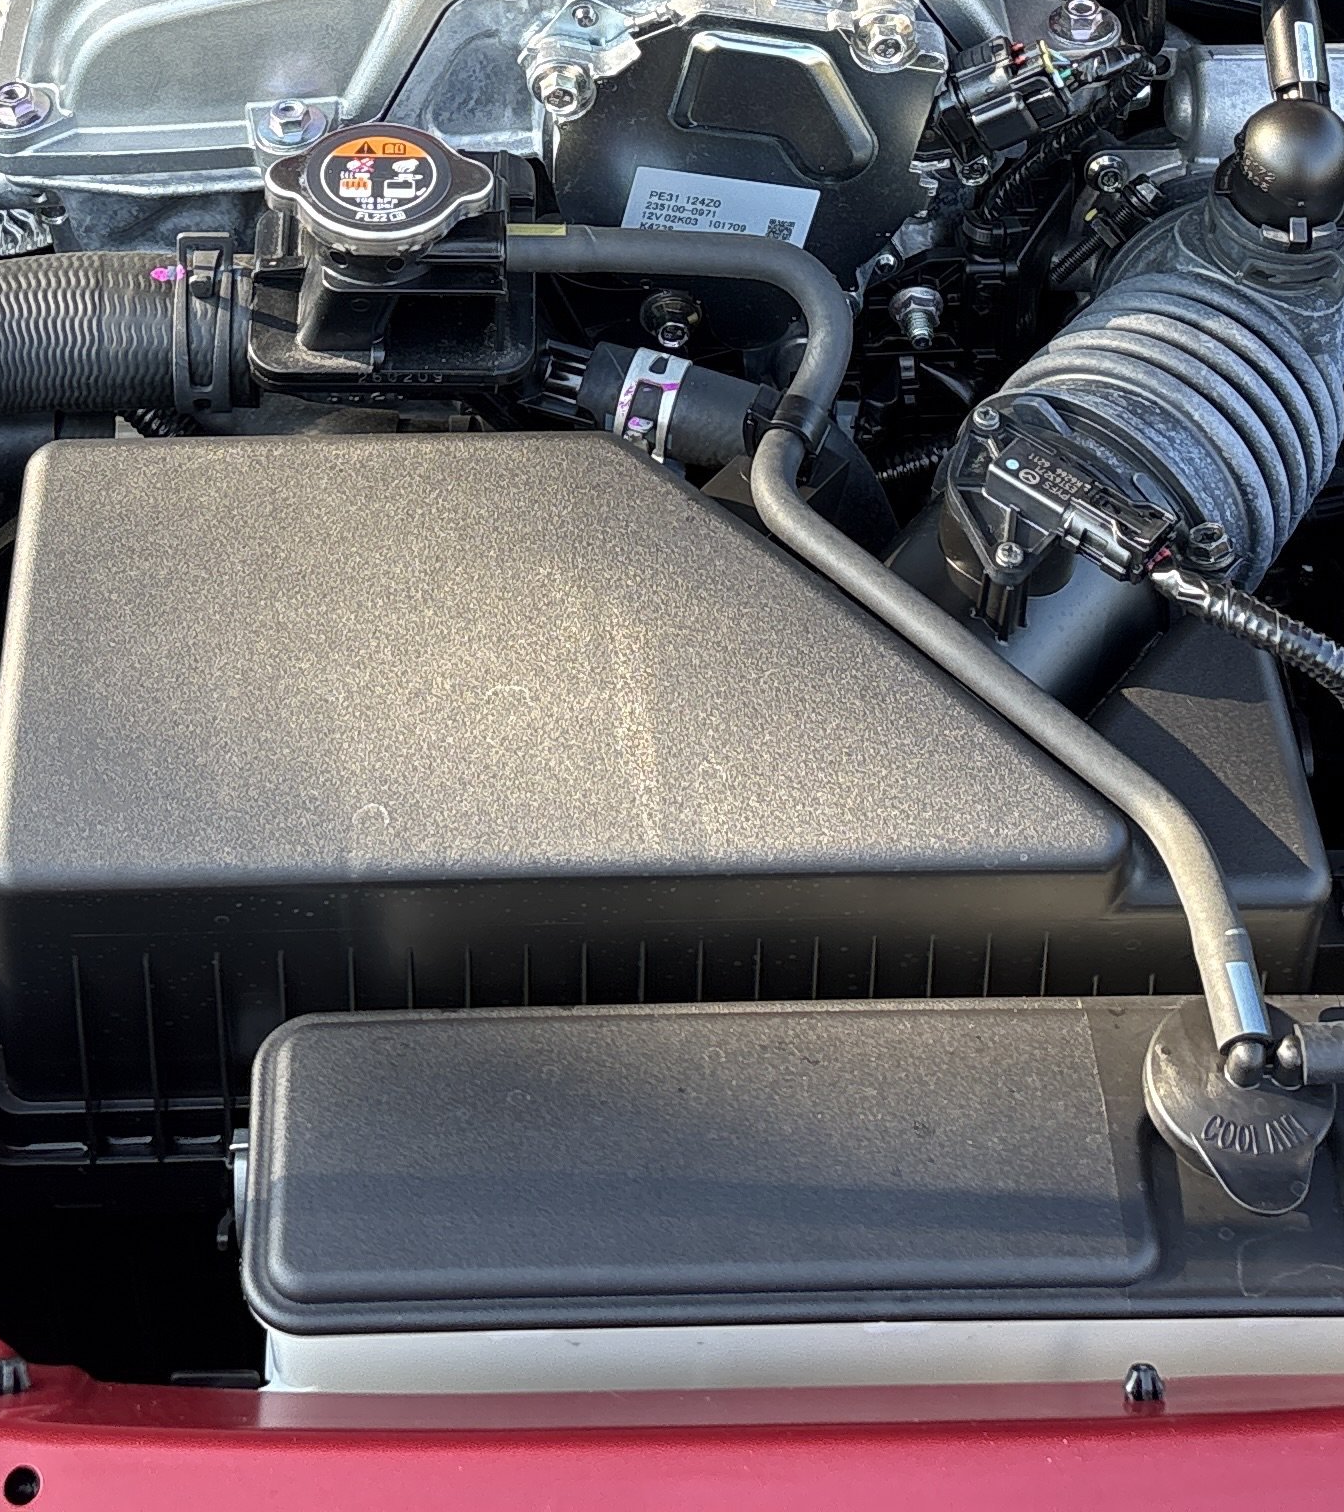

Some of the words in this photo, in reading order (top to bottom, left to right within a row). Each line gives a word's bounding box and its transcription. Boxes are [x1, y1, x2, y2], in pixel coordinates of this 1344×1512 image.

[648, 190, 680, 203] PE31
[645, 201, 718, 218] 235100-0971
[355, 211, 388, 222] FL22
